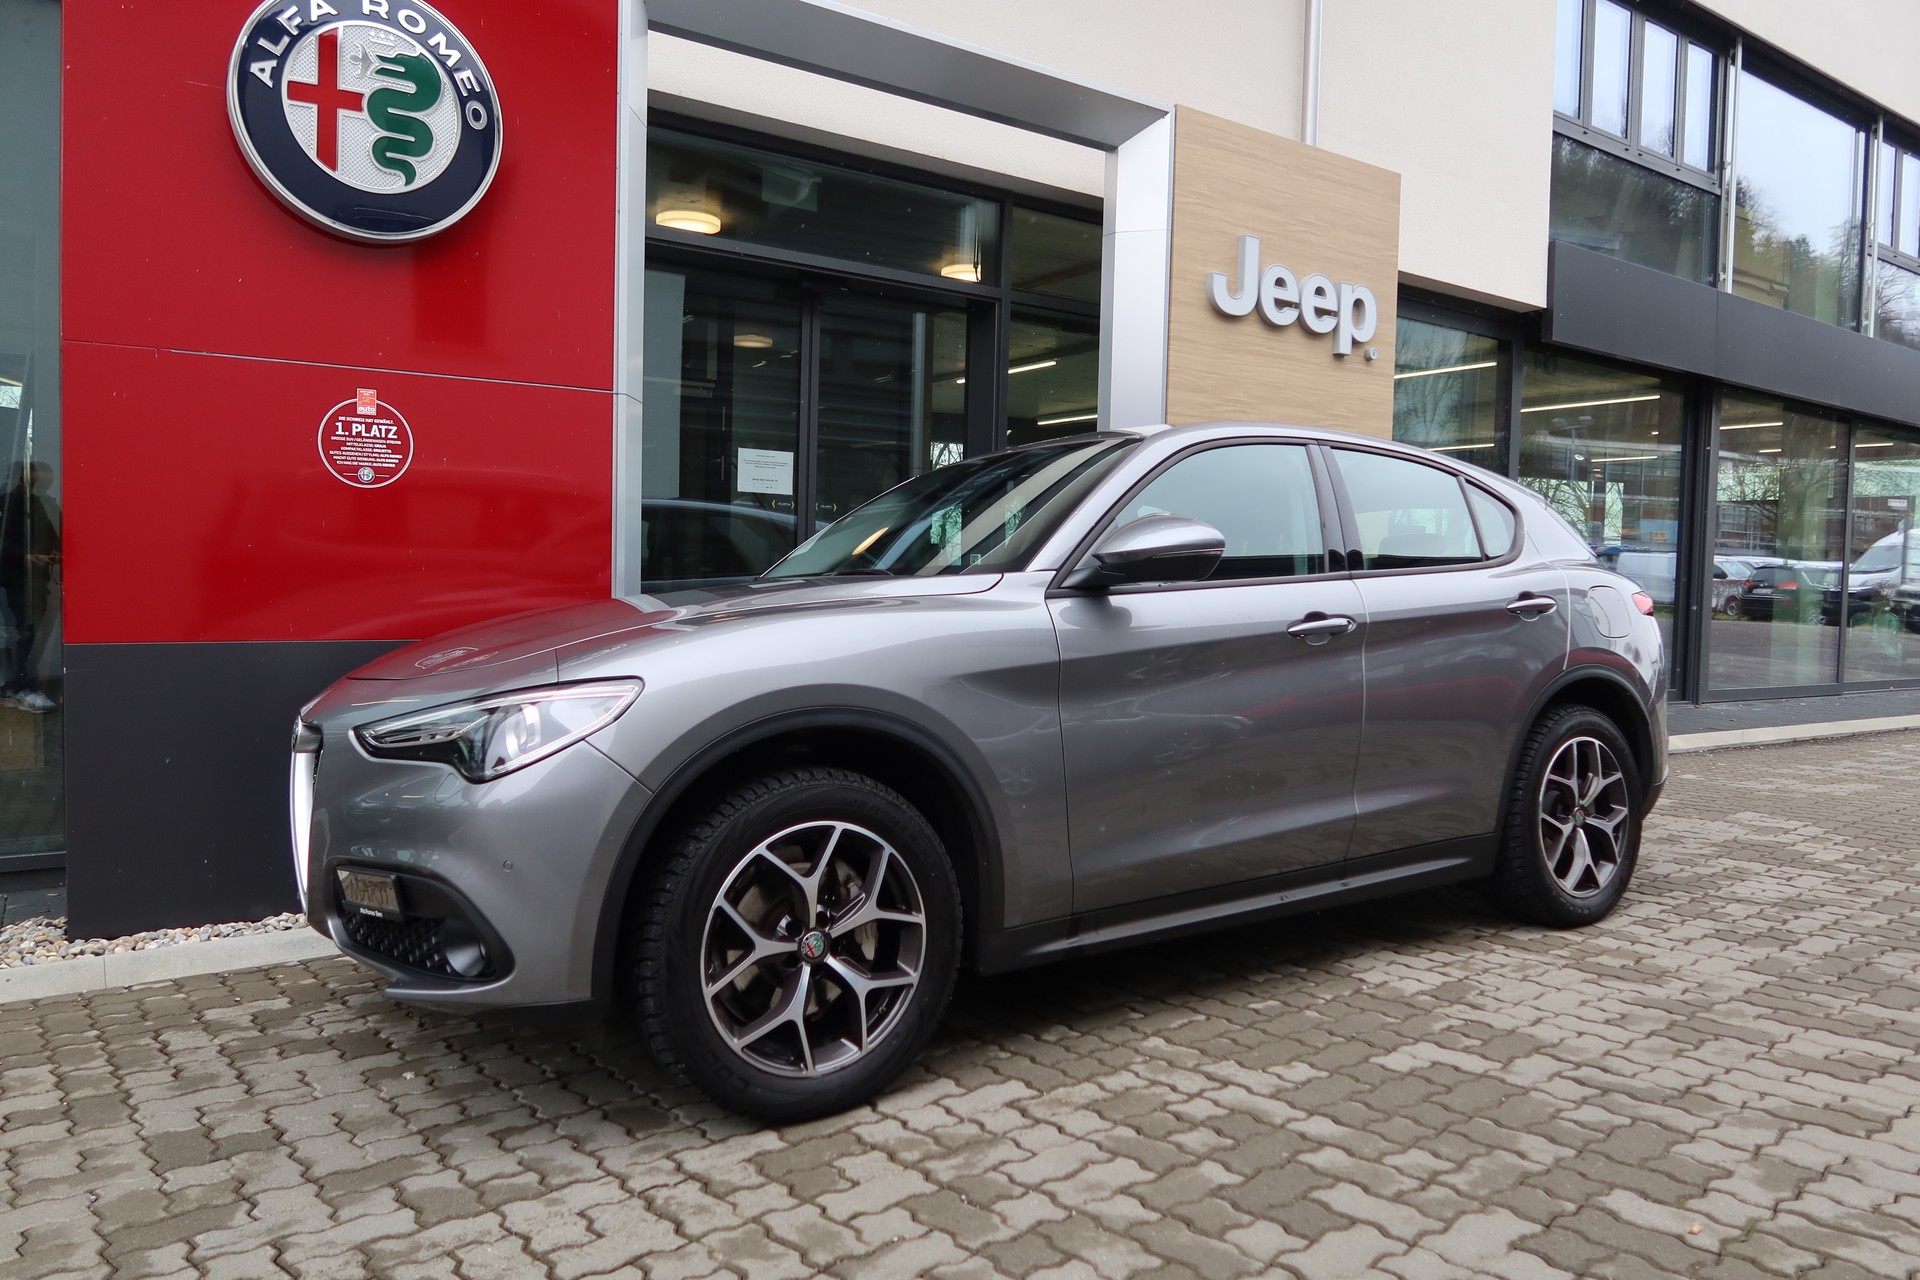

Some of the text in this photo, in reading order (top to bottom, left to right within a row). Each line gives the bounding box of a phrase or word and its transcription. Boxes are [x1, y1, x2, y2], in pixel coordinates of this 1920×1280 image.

[250, 0, 488, 130] ALFA ROMEO
[1206, 234, 1377, 357] Jeep
[335, 422, 398, 438] 1. PLATZ
